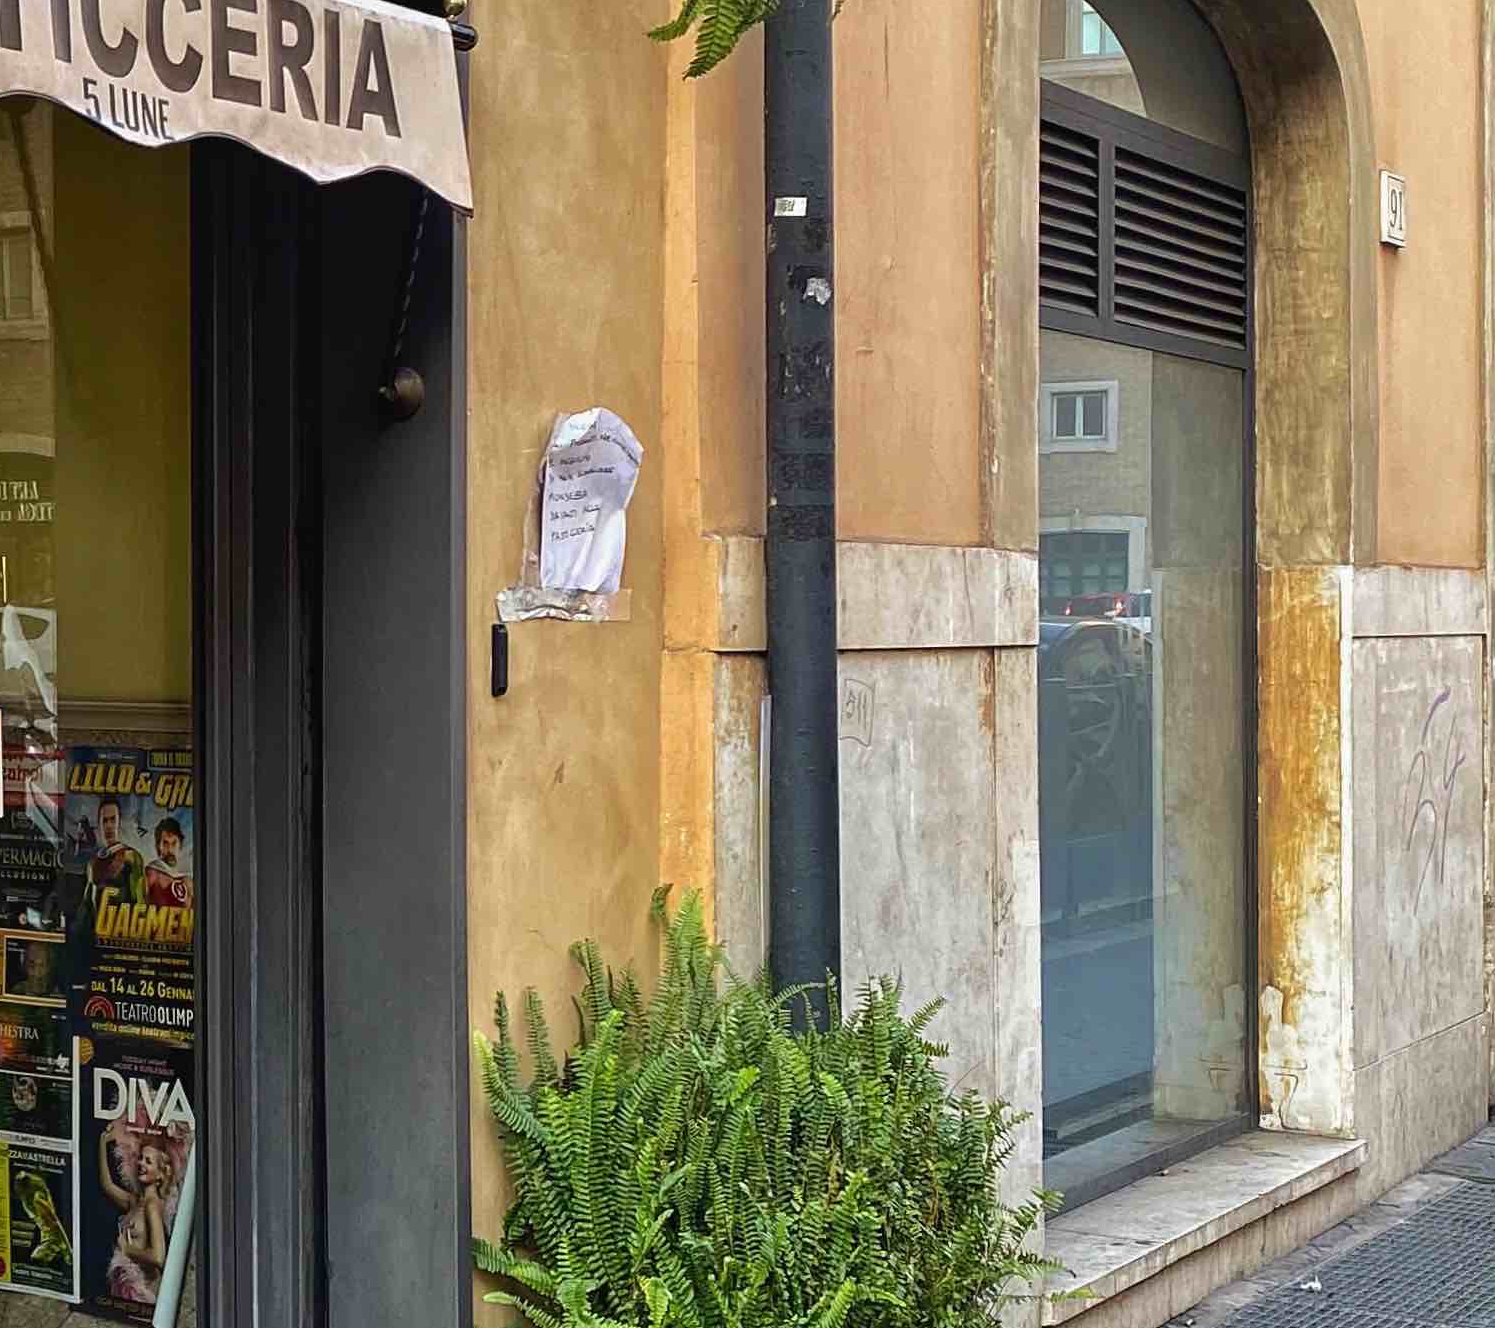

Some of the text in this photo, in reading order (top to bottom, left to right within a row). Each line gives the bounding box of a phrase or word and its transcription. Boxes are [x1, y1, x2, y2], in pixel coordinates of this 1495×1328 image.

[81, 76, 175, 141] 5 LUNE
[1389, 188, 1403, 231] 91
[69, 763, 136, 794] LILLO
[135, 772, 151, 795] &
[90, 980, 106, 992] DAL
[109, 976, 125, 994] 14
[126, 983, 138, 996] AL
[139, 979, 155, 998] 26
[93, 1066, 196, 1132] DIVA
